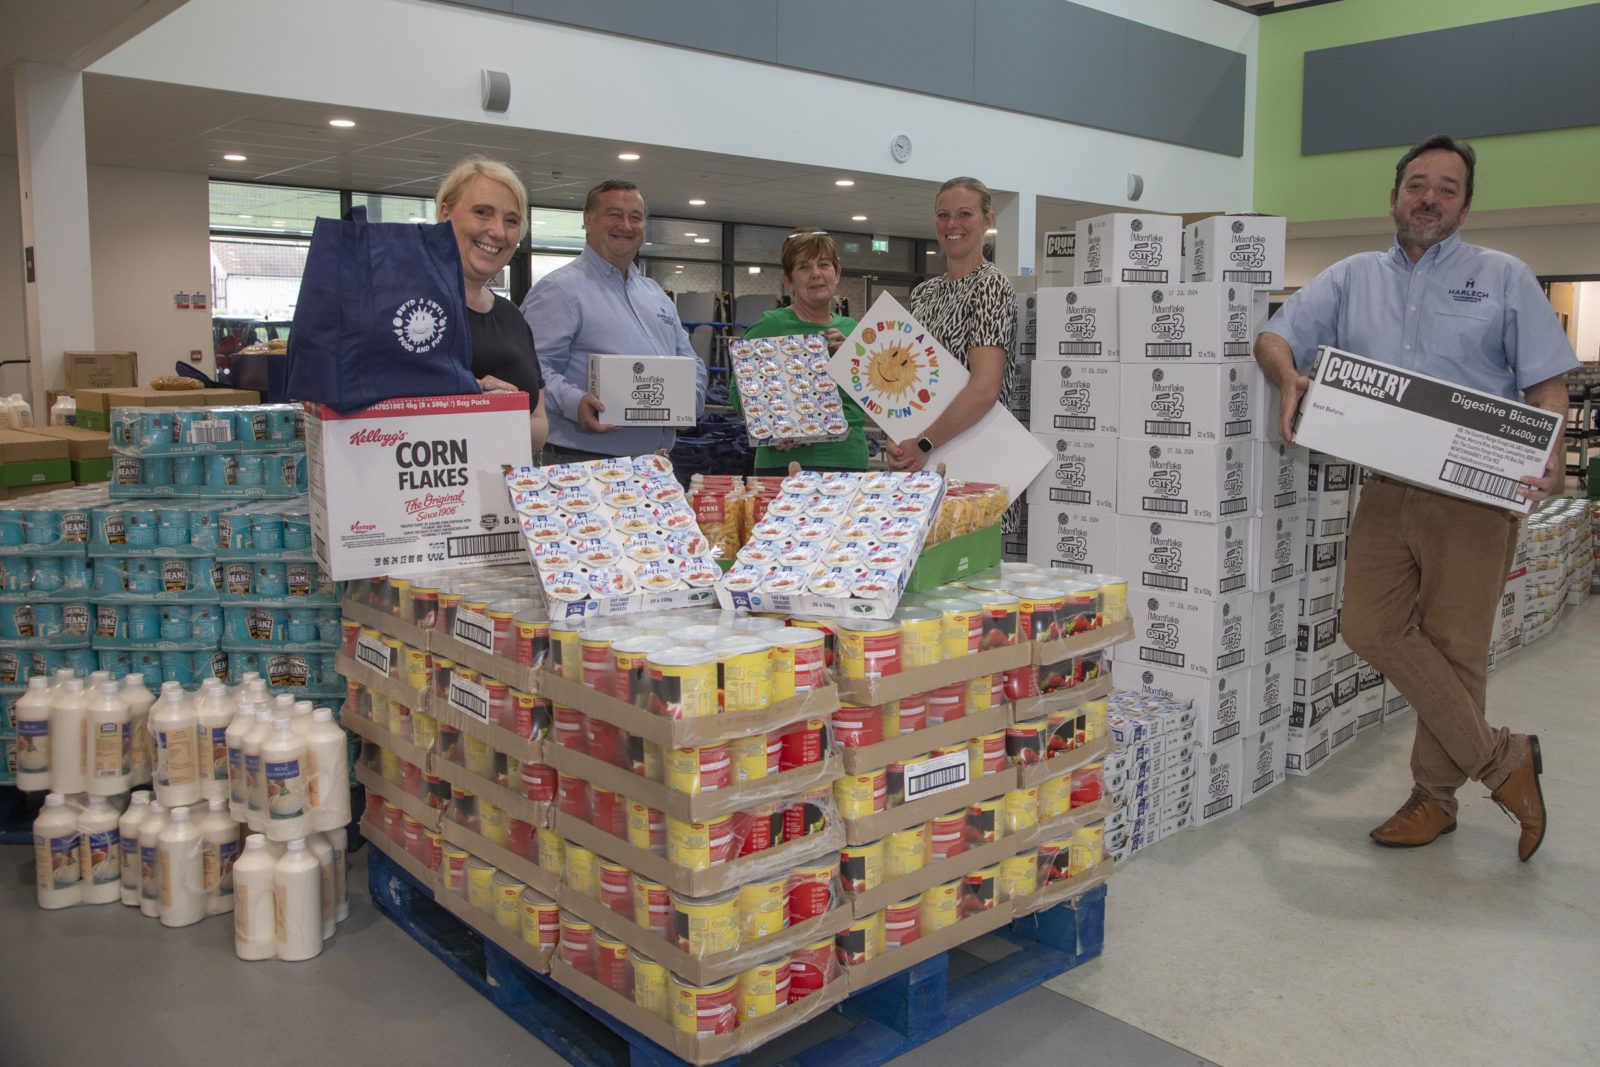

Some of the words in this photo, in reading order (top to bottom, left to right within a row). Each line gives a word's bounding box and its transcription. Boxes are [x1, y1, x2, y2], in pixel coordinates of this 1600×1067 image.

[1048, 236, 1075, 255] COUN
[1448, 289, 1489, 298] HARLECH
[396, 300, 416, 316] BWYD
[1152, 304, 1184, 314] Mornflake
[398, 336, 414, 352] FOOD
[416, 345, 430, 353] AND
[431, 333, 443, 348] FUN
[877, 320, 912, 334] BWYD
[916, 334, 924, 344] A
[924, 346, 939, 386] HWYL
[1152, 383, 1184, 392] Mornflake
[1325, 357, 1411, 402] COUNTRY
[850, 358, 863, 392] FOOD
[860, 396, 883, 415] AND
[887, 406, 912, 418] FUN
[1342, 380, 1386, 398] RANGE
[1313, 402, 1324, 410] Best
[1451, 392, 1506, 417] Digestive
[1509, 409, 1554, 431] Biscuits
[350, 428, 406, 447] Kellogg's
[1499, 424, 1537, 443] 21x400g
[396, 439, 468, 468] CORN
[1150, 460, 1182, 470] Mornflake
[398, 467, 468, 491] FLAKES
[404, 499, 423, 513] The
[424, 490, 465, 507] Original
[416, 510, 438, 522] Since
[438, 506, 456, 517] 1906
[504, 516, 509, 524] 8
[64, 522, 88, 531] BEANZ
[107, 524, 125, 533] BEA
[164, 571, 187, 580] BEANZ
[227, 574, 250, 582] BEANZ
[1502, 592, 1516, 607] CORN
[1148, 612, 1179, 624] Mornflake
[214, 662, 226, 670] BEA
